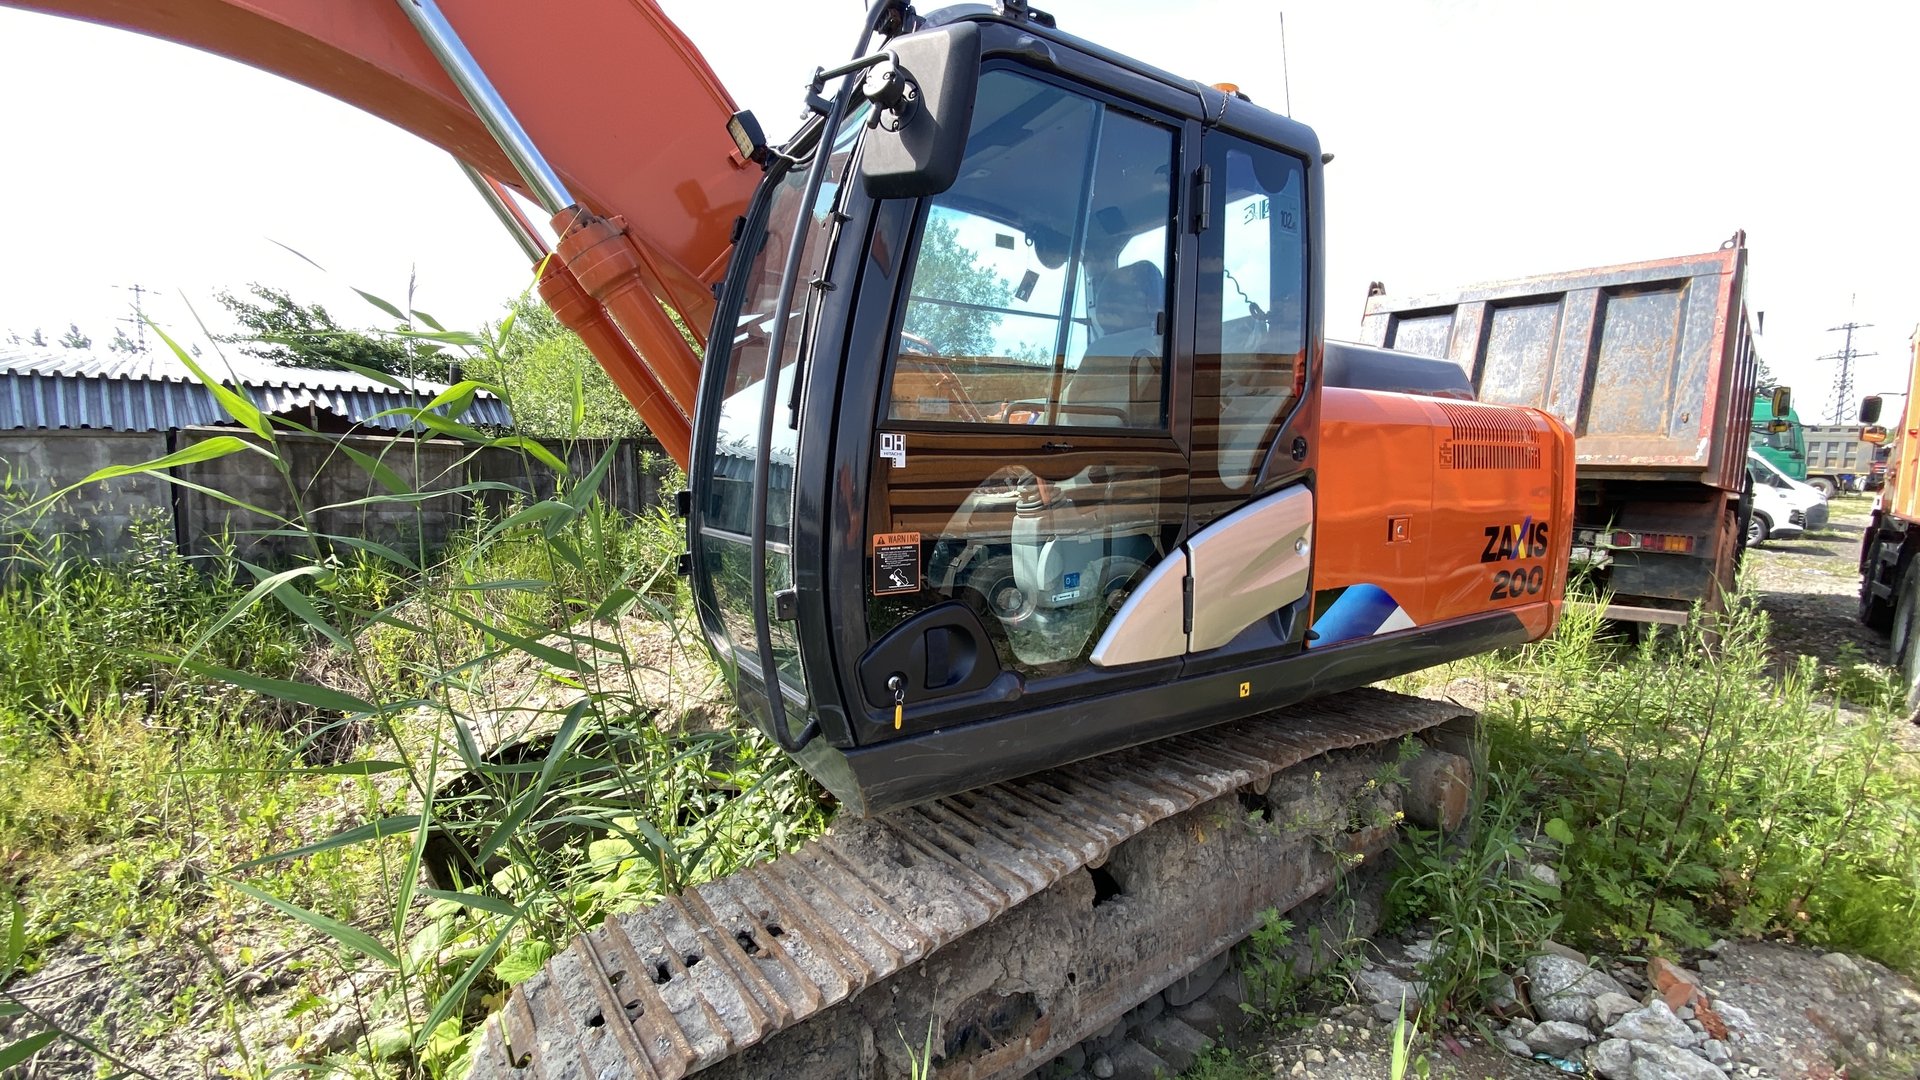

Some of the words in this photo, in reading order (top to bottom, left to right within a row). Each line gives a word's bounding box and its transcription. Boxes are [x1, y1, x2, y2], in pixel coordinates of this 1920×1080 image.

[888, 534, 919, 544] WARNING
[1481, 515, 1549, 563] ZAXIS
[1489, 565, 1544, 601] 200
